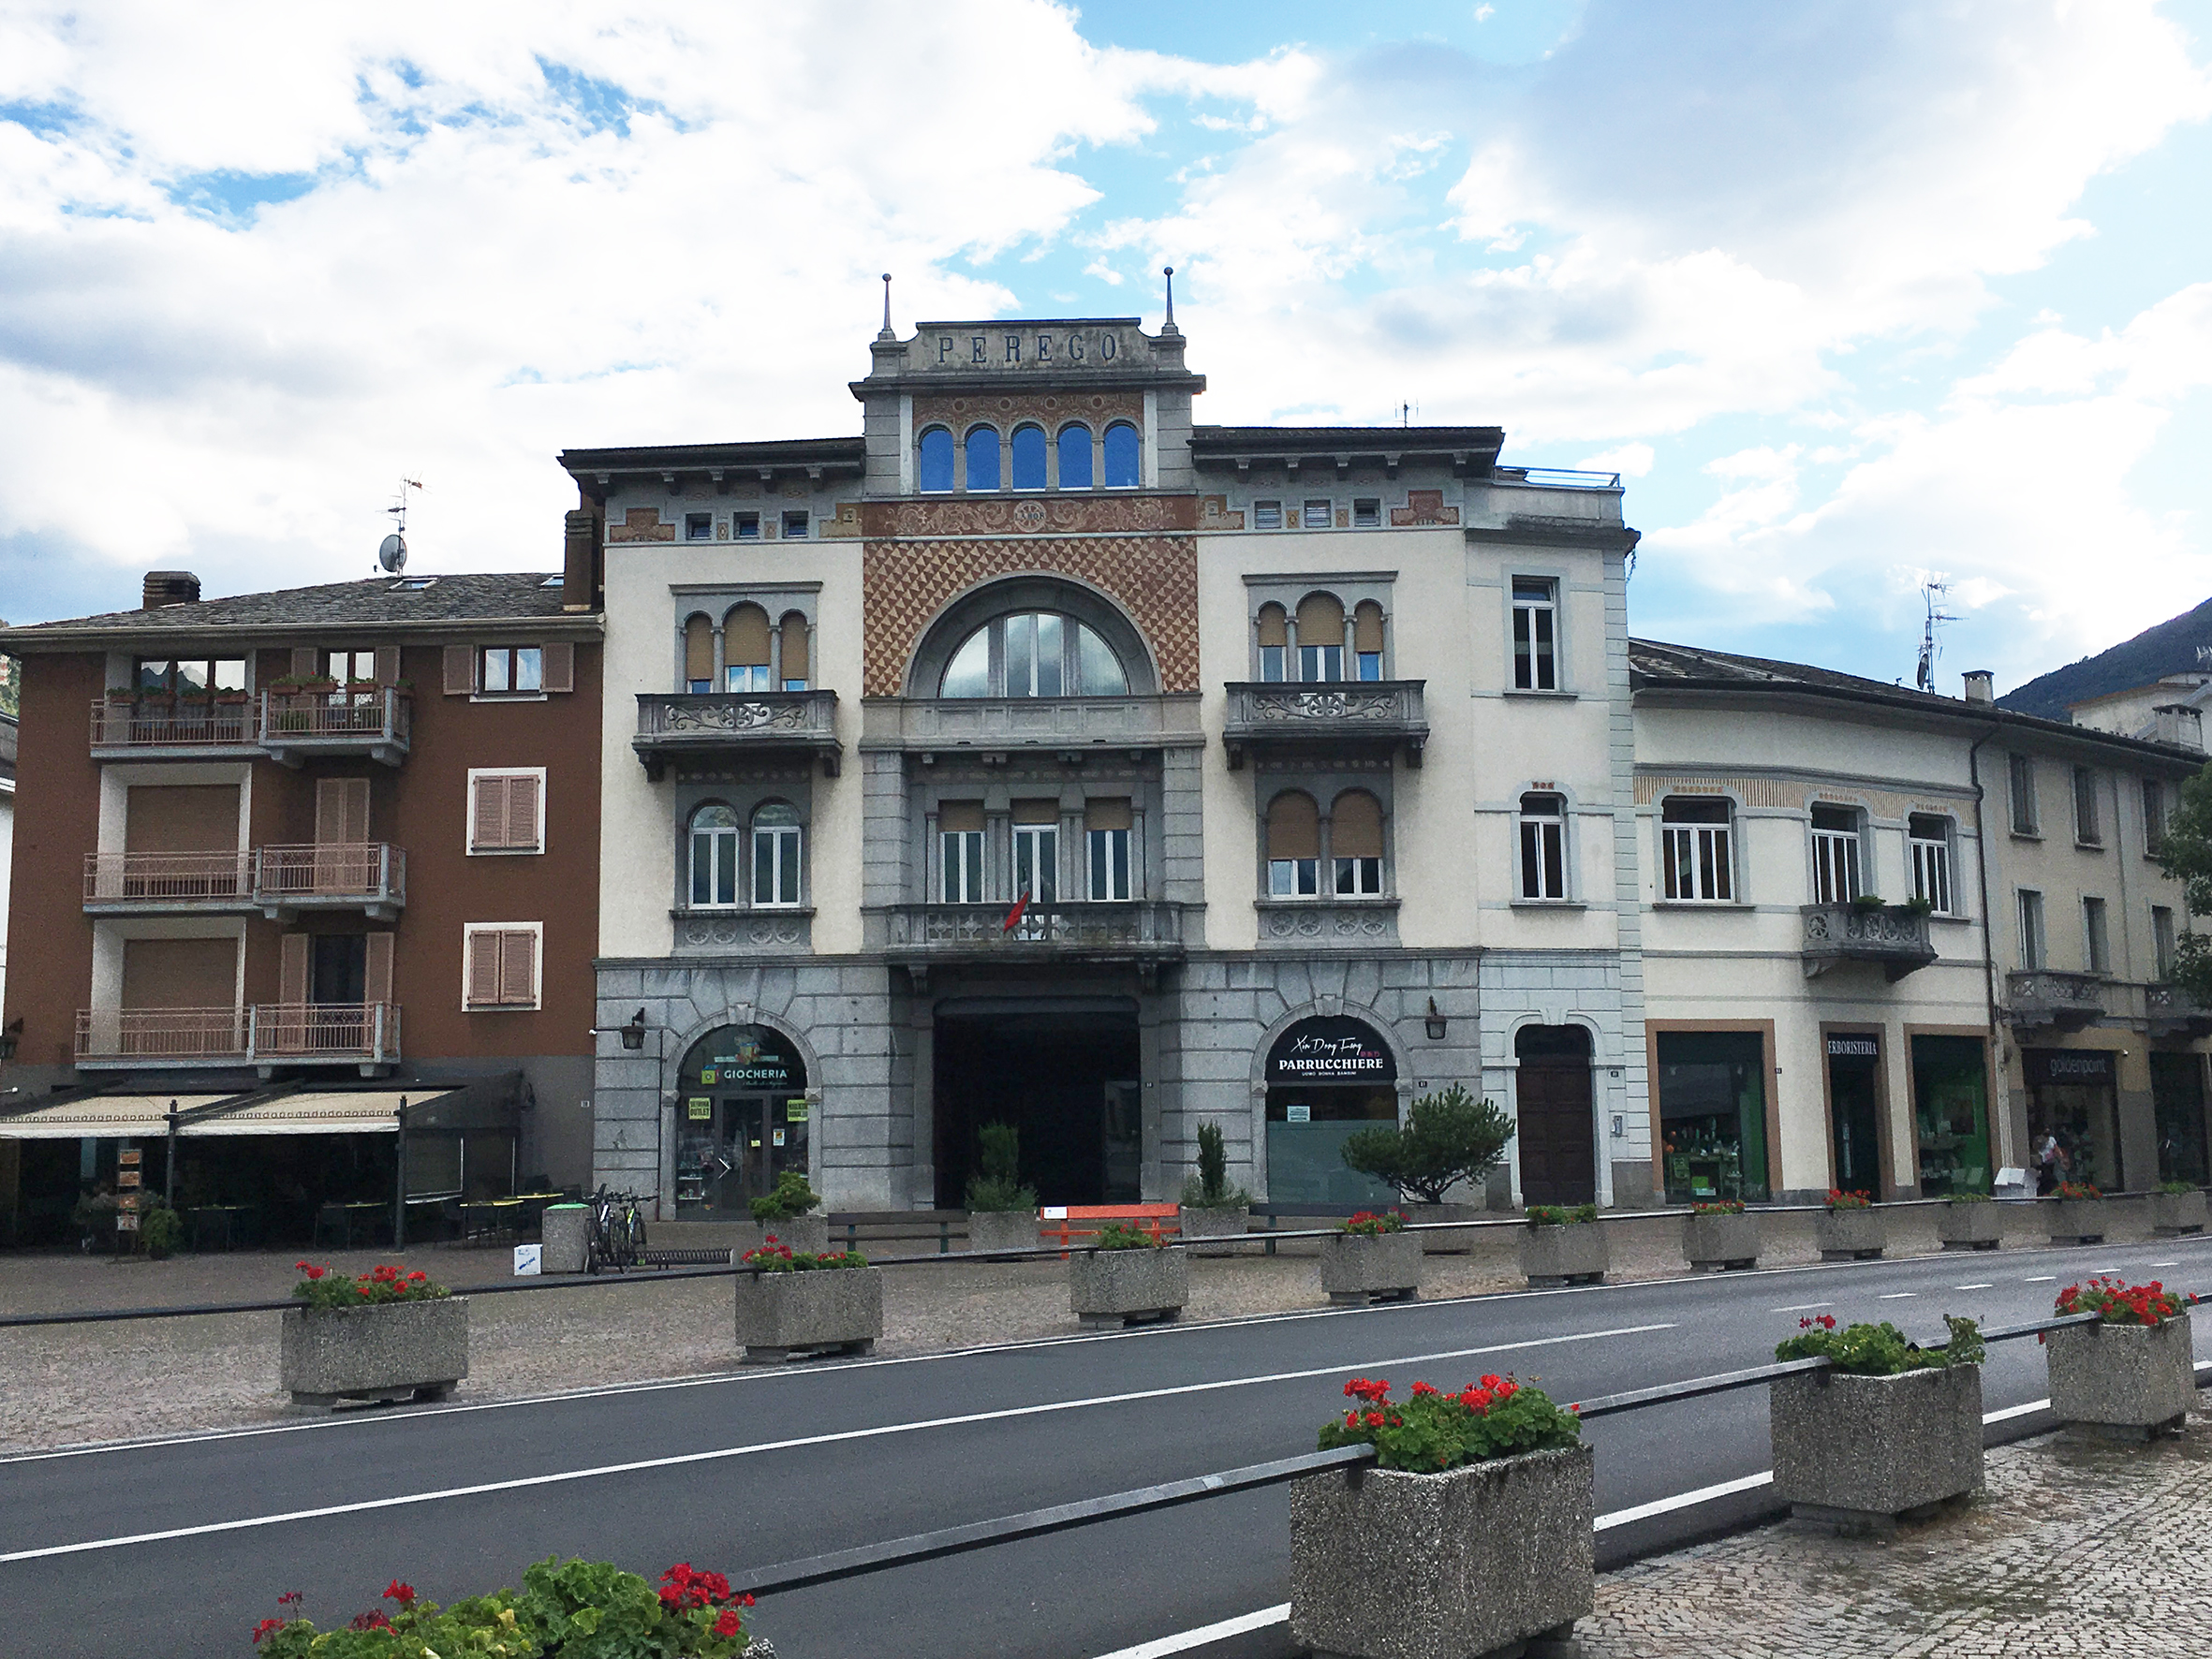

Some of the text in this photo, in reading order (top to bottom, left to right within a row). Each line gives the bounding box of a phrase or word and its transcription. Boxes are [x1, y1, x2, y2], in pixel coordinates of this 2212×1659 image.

[937, 334, 1117, 363] PEREGO
[1014, 511, 1045, 521] LABOR
[1827, 1040, 1878, 1055] ERBORISTERIA
[1278, 1058, 1384, 1070] PARRUCCHIERE
[2050, 1054, 2106, 1077] goldenpoint
[724, 1069, 788, 1079] GIOCHERIA
